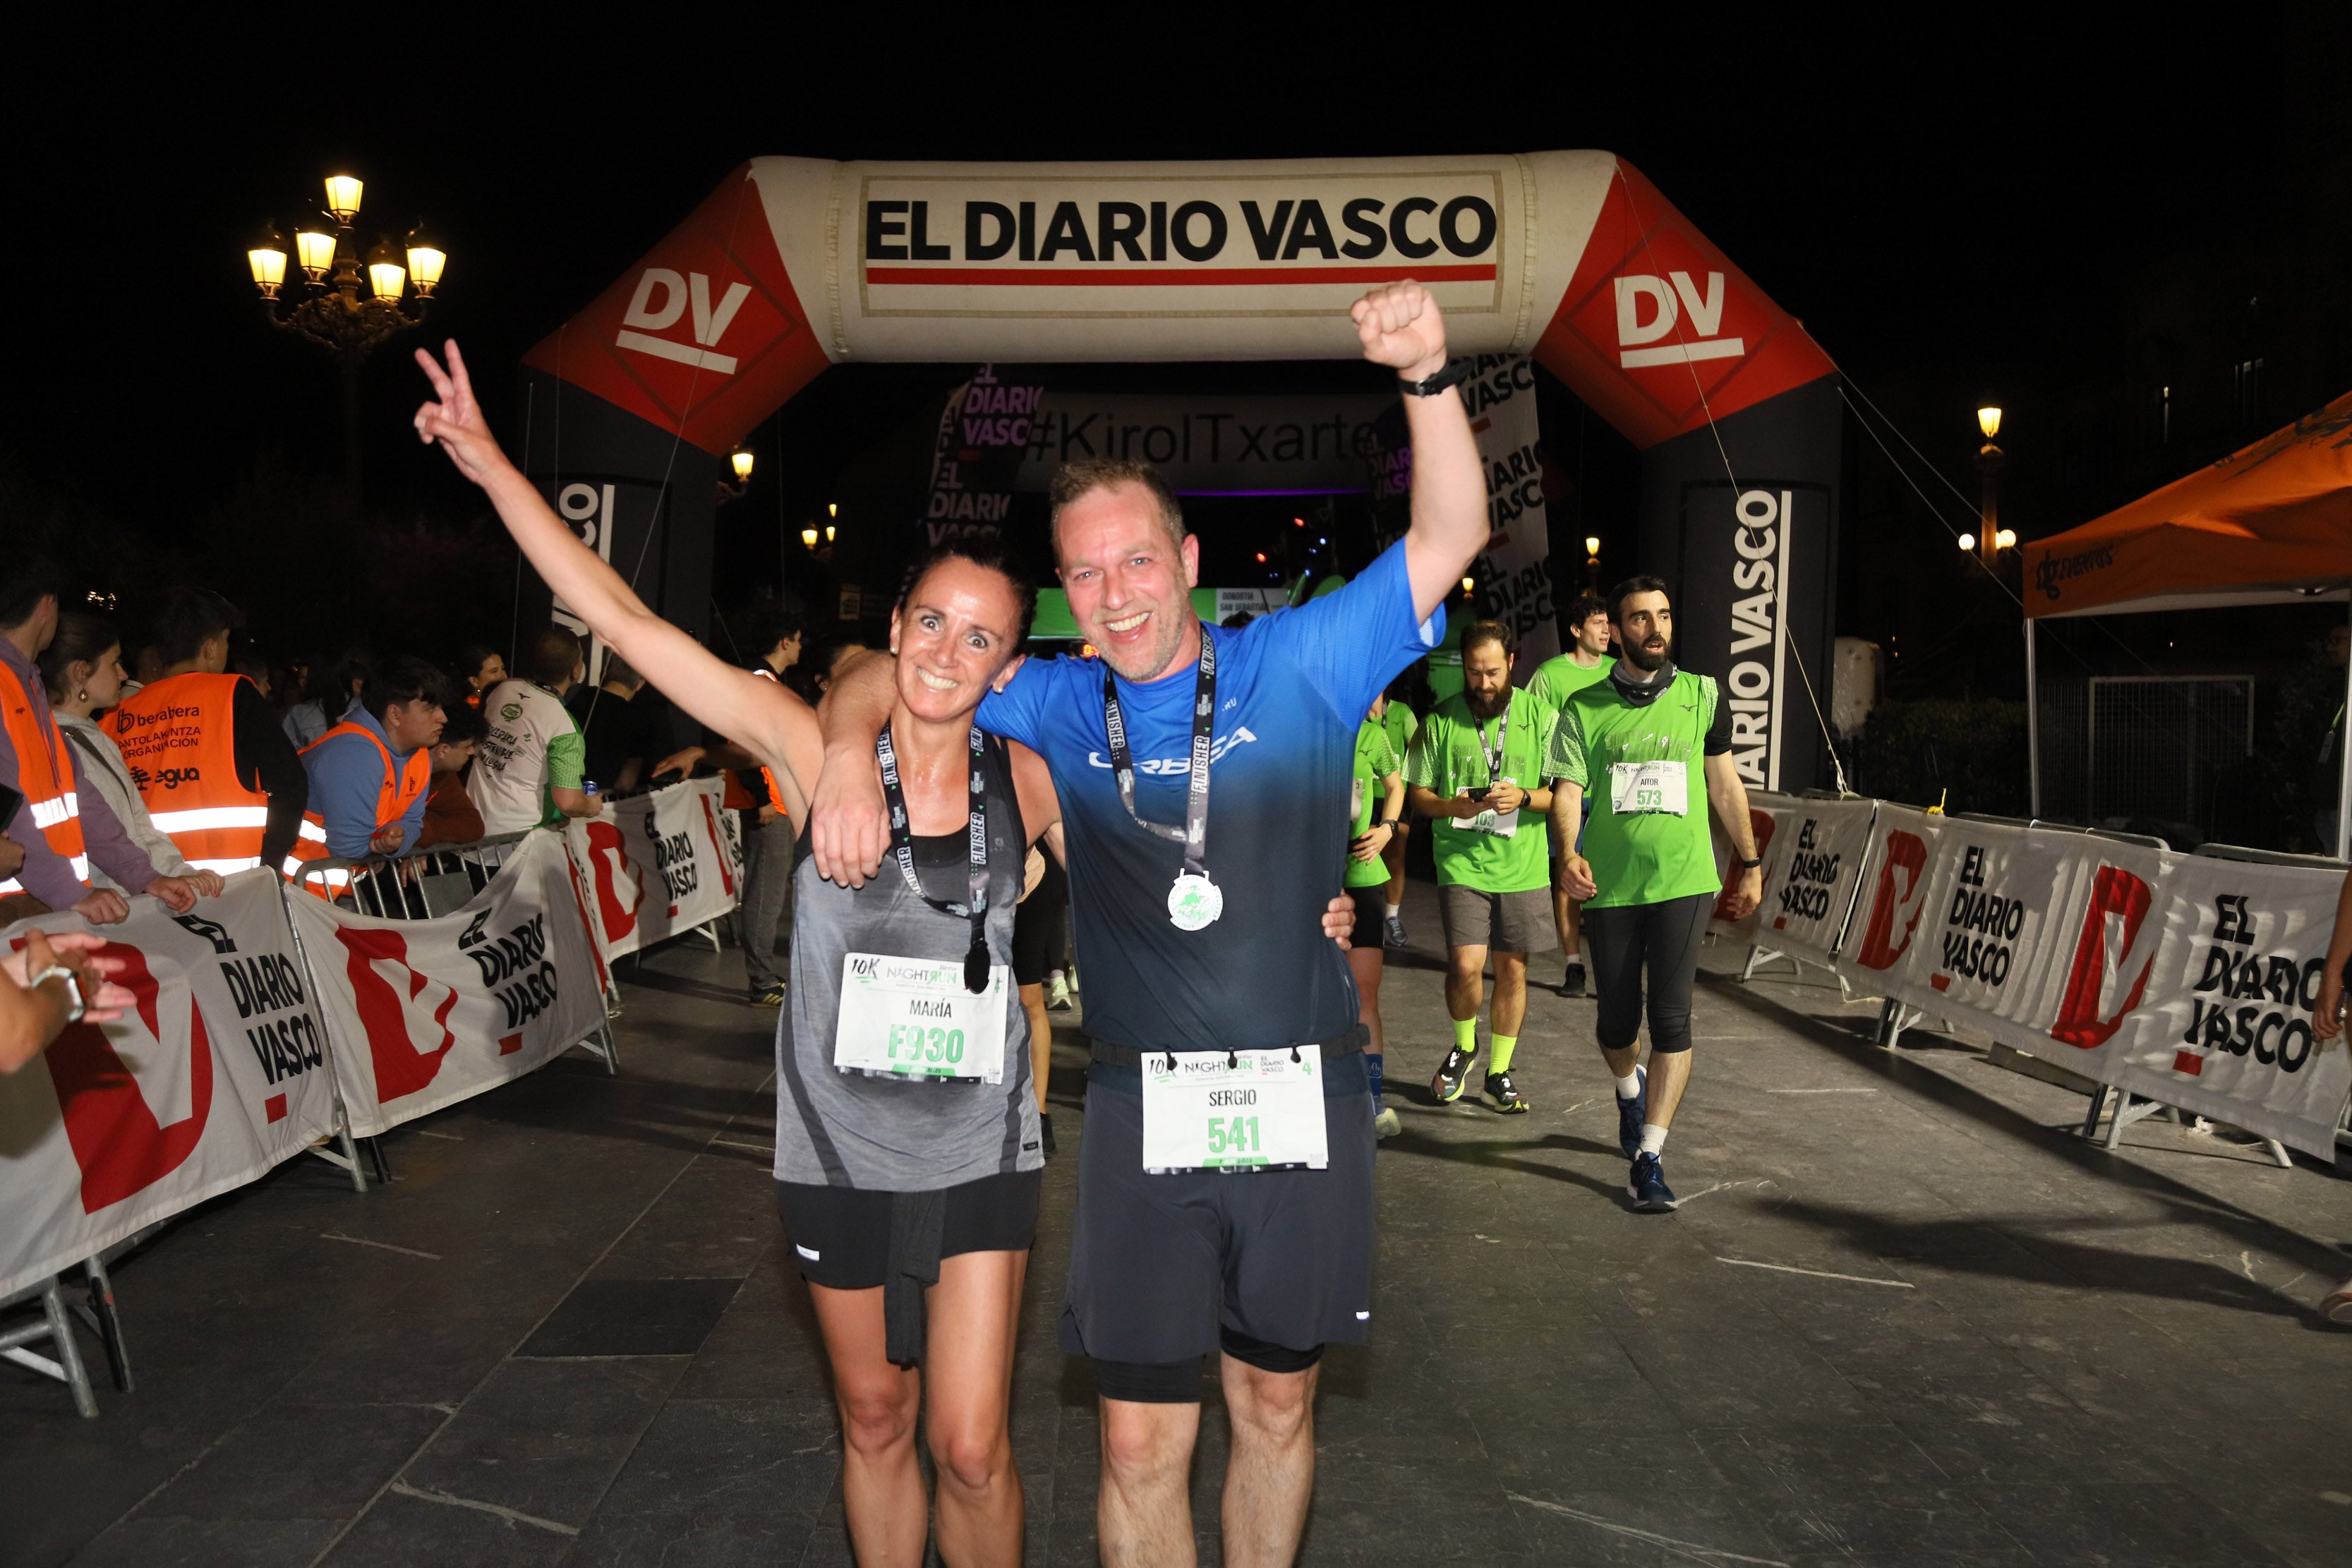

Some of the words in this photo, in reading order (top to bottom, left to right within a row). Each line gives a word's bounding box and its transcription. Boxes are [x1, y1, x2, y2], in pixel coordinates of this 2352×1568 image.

[867, 200, 951, 260] EL
[965, 200, 1228, 262] DIARIO
[1238, 195, 1497, 260] VASCO
[622, 268, 752, 347] DV
[1614, 271, 1725, 346] DV
[1460, 358, 1536, 418] VASC
[963, 418, 1032, 446] VASC
[1731, 490, 1778, 655] VASCO
[138, 706, 199, 726] berabera
[1106, 699, 1126, 749] FINISHER
[1729, 661, 1770, 790] ARIO
[878, 731, 898, 785] FINISHER
[1191, 735, 1210, 794] FINISHER
[1637, 790, 1662, 805] 573
[644, 811, 661, 840] EL
[970, 812, 987, 865] FINISHER
[1799, 819, 1817, 850] EL
[654, 831, 694, 870] DIARIO
[1960, 845, 1984, 886] EL
[662, 862, 698, 901] VASCO
[1778, 884, 1829, 921] VASCO
[171, 915, 238, 954] EL
[459, 907, 493, 950] EL
[1948, 888, 2023, 941] DIARIO
[2213, 893, 2256, 946] EL
[852, 958, 880, 980] 10K
[1943, 931, 2010, 987] VASCO
[2193, 946, 2326, 1012] DIARIO
[219, 953, 305, 1019] DIARIO
[910, 999, 951, 1018] MARÍA
[246, 1013, 322, 1085] VASCO
[888, 1024, 964, 1063] F930
[2184, 999, 2312, 1073] VASCO
[1302, 1061, 1313, 1075] 4
[1210, 1090, 1256, 1106] SERGIO
[1208, 1116, 1260, 1153] 541
